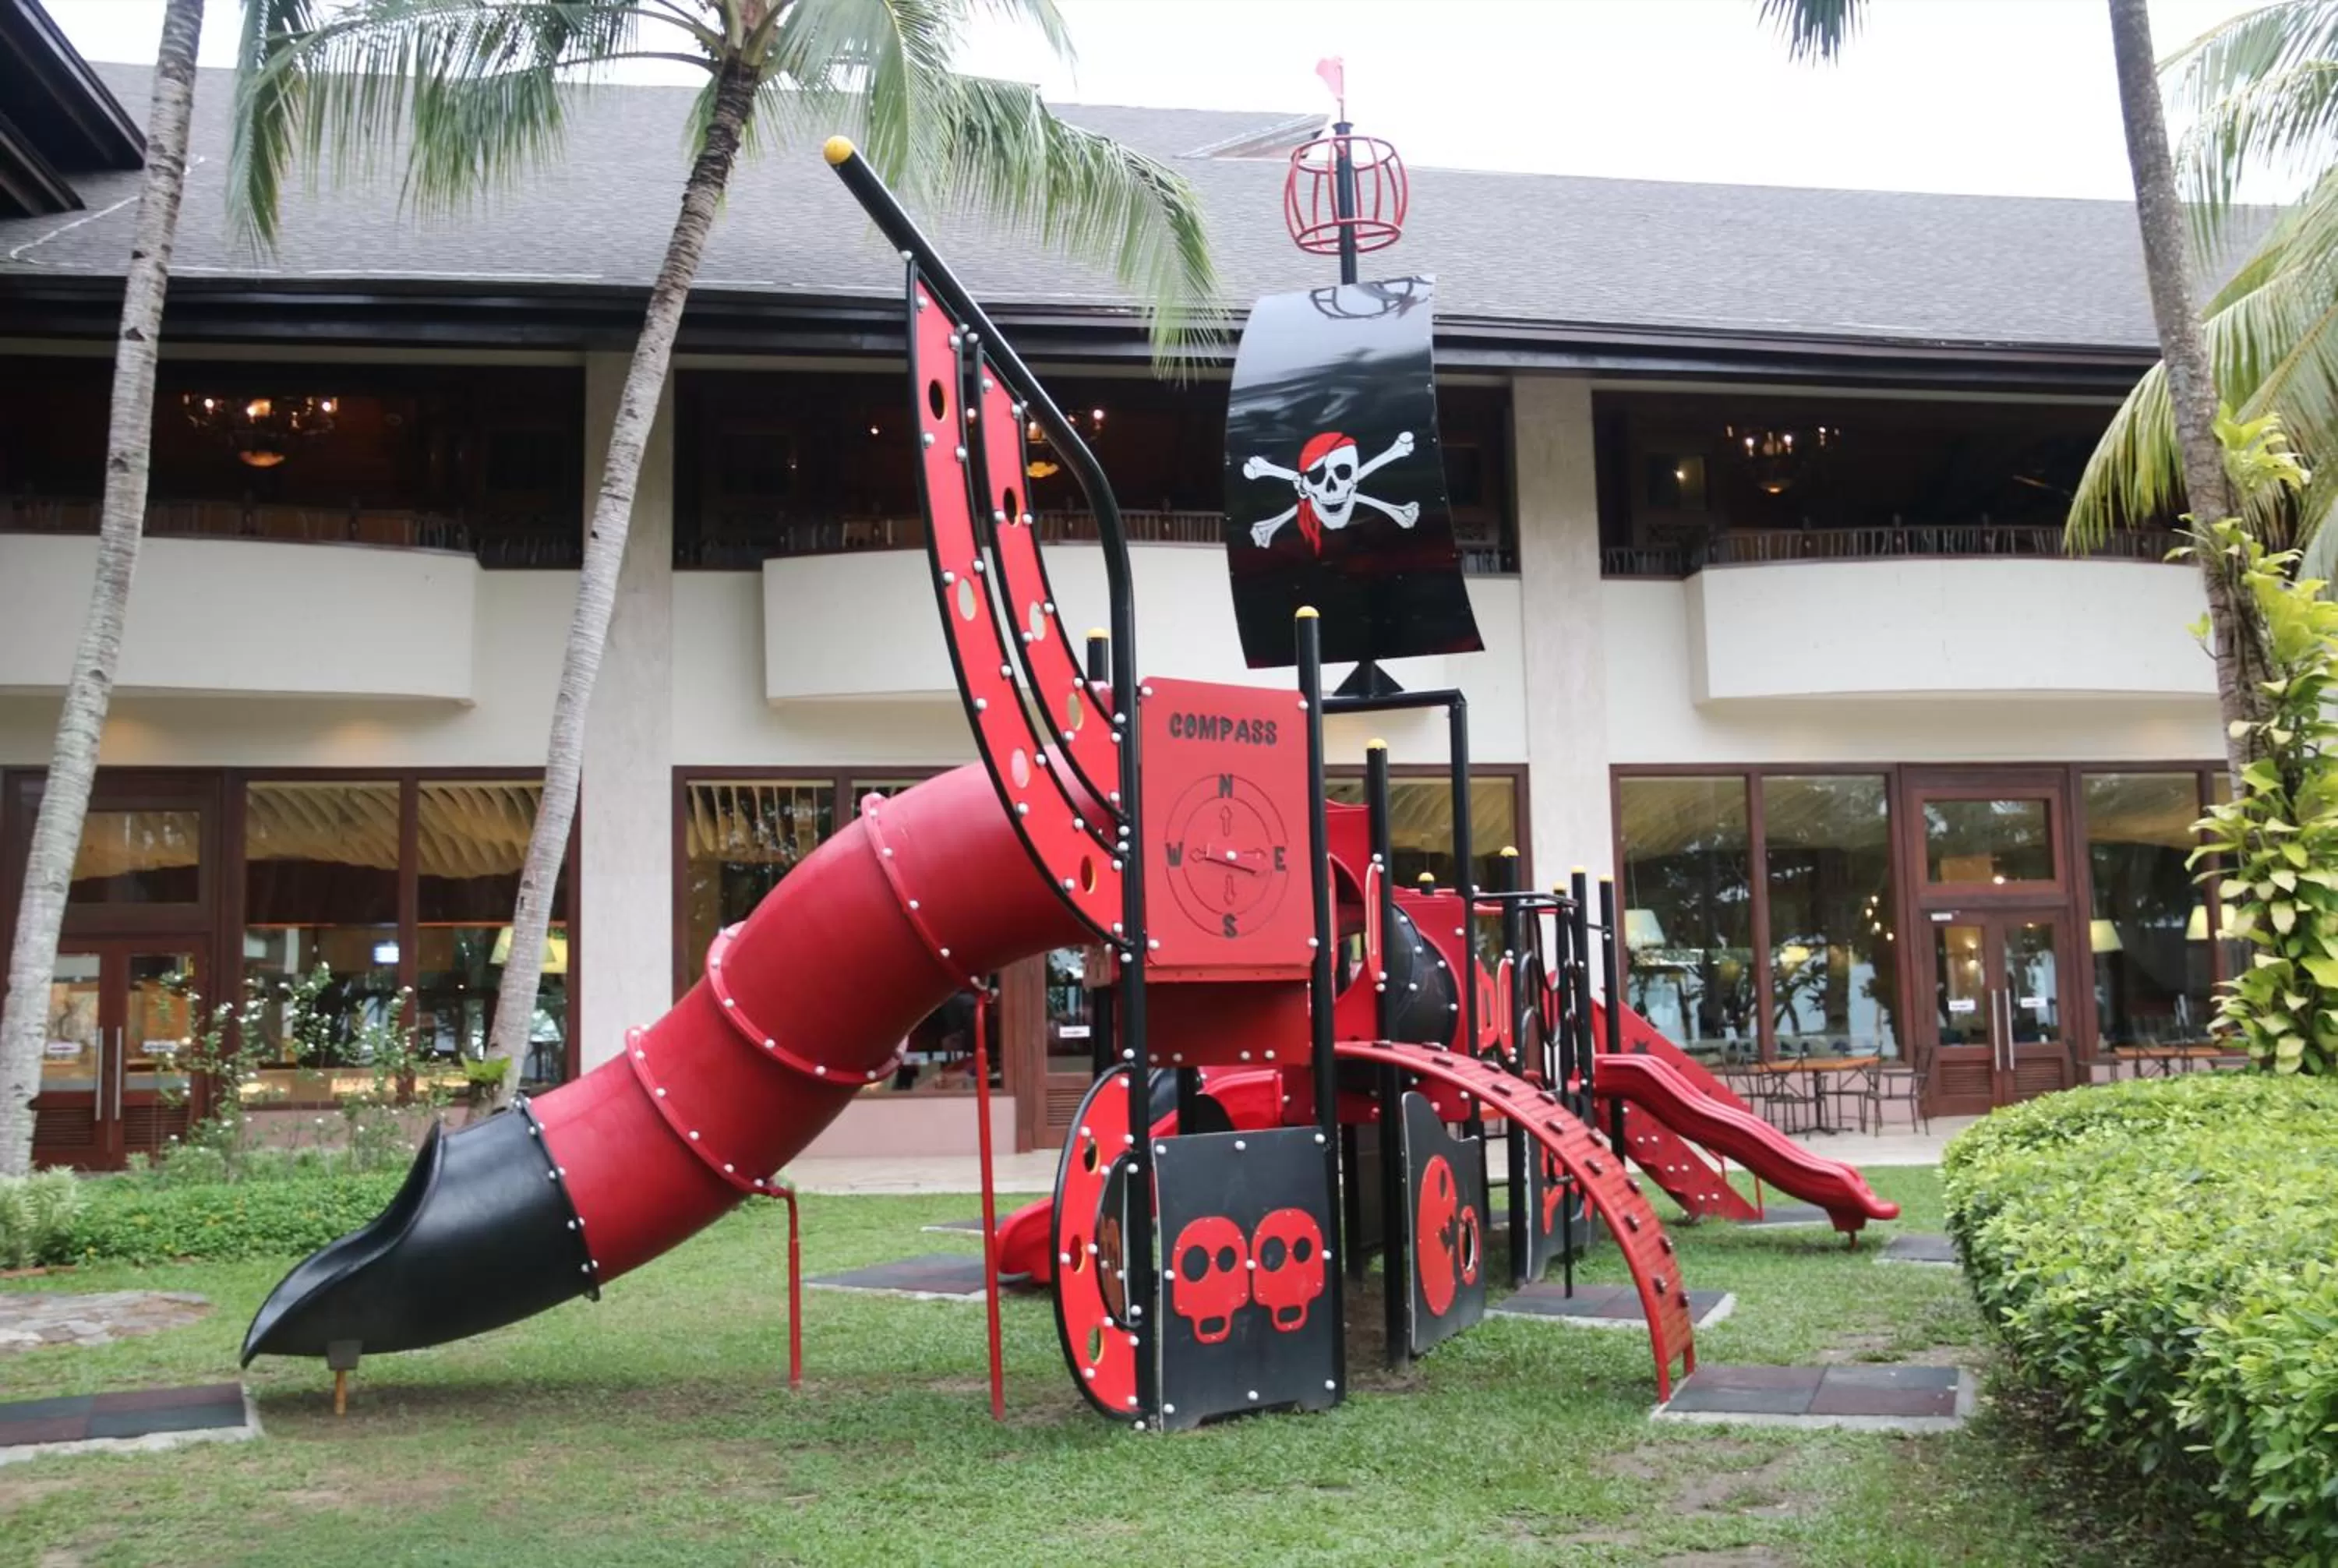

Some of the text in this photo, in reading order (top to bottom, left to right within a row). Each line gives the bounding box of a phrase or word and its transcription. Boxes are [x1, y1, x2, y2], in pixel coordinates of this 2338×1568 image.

[1170, 712, 1277, 745] COMPASS
[1218, 773, 1233, 799] N
[1165, 841, 1184, 867] W
[1273, 846, 1286, 871] E
[1222, 913, 1238, 938] S
